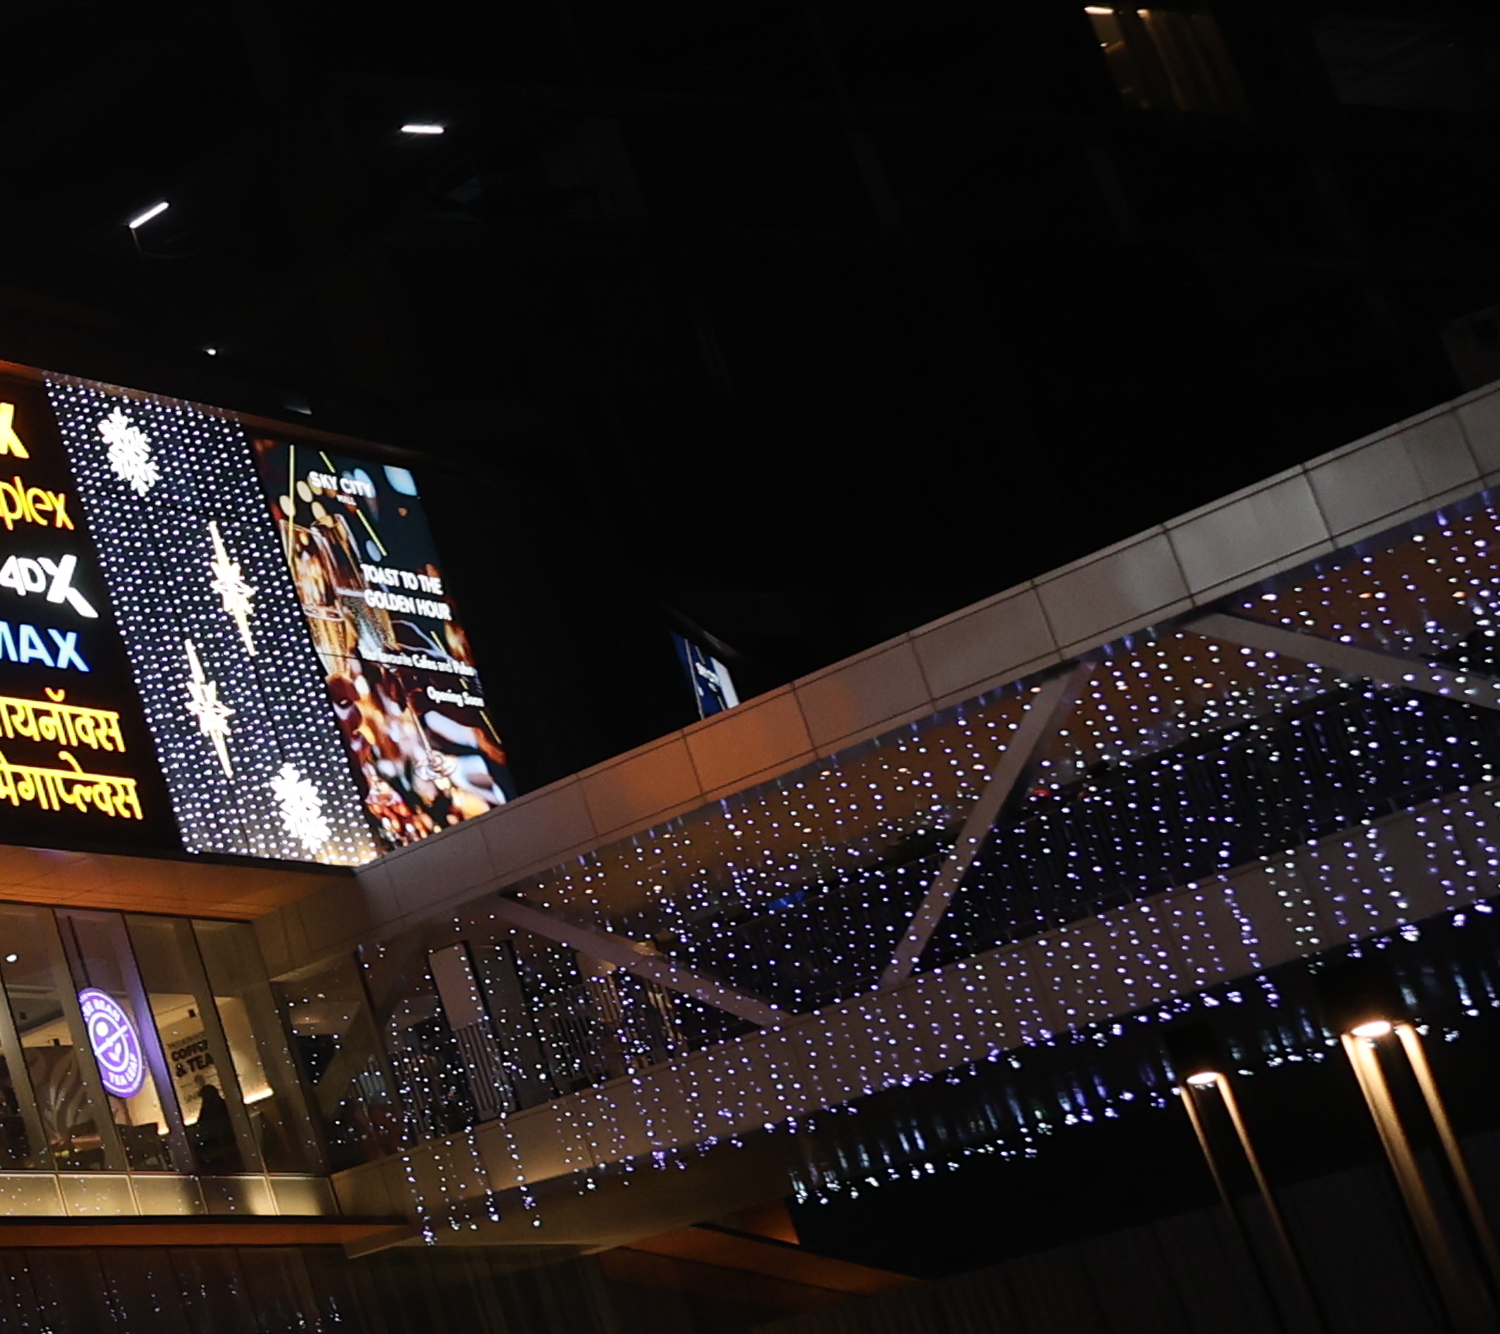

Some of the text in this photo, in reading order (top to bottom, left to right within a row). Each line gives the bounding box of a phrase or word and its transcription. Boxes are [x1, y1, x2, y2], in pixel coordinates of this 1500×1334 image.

[309, 470, 374, 498] SKY CITY
[360, 564, 444, 595] TOAST TO THE
[364, 589, 452, 621] GOLDEN HOUR
